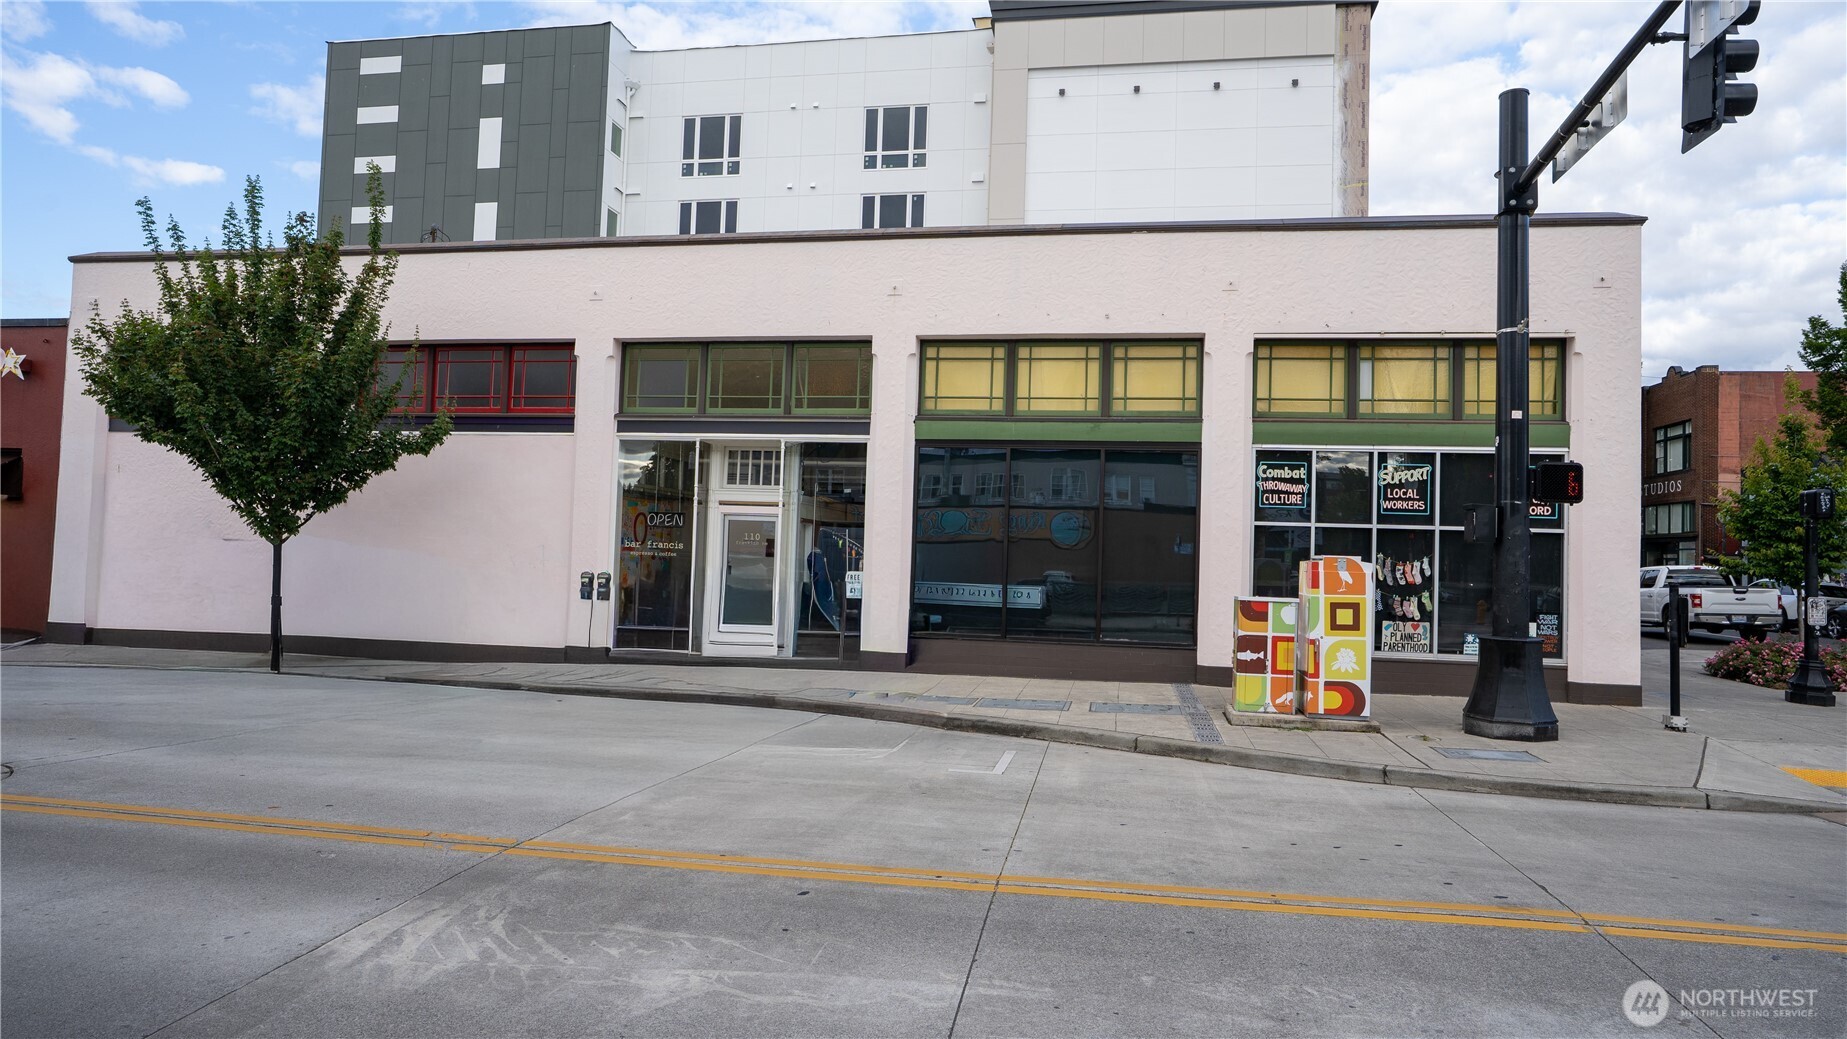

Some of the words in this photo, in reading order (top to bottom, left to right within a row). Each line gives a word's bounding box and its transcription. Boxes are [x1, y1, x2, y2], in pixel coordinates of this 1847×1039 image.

[1259, 464, 1306, 479] Combat
[1380, 466, 1430, 485] SUPPORT
[1259, 480, 1307, 493] THROWAWAY
[1643, 479, 1682, 496] TUDIOS
[1263, 493, 1303, 504] CULTURE
[1387, 488, 1420, 499] LOCAL
[1382, 500, 1426, 510] WORKERS
[1529, 505, 1552, 516] ORD
[647, 512, 684, 527] OPEN
[744, 532, 761, 541] 110
[625, 539, 642, 548] bar
[647, 540, 684, 549] francis
[1392, 622, 1407, 632] OLY
[1390, 632, 1422, 643] PLANNED
[1382, 642, 1428, 653] PARENTHOOD
